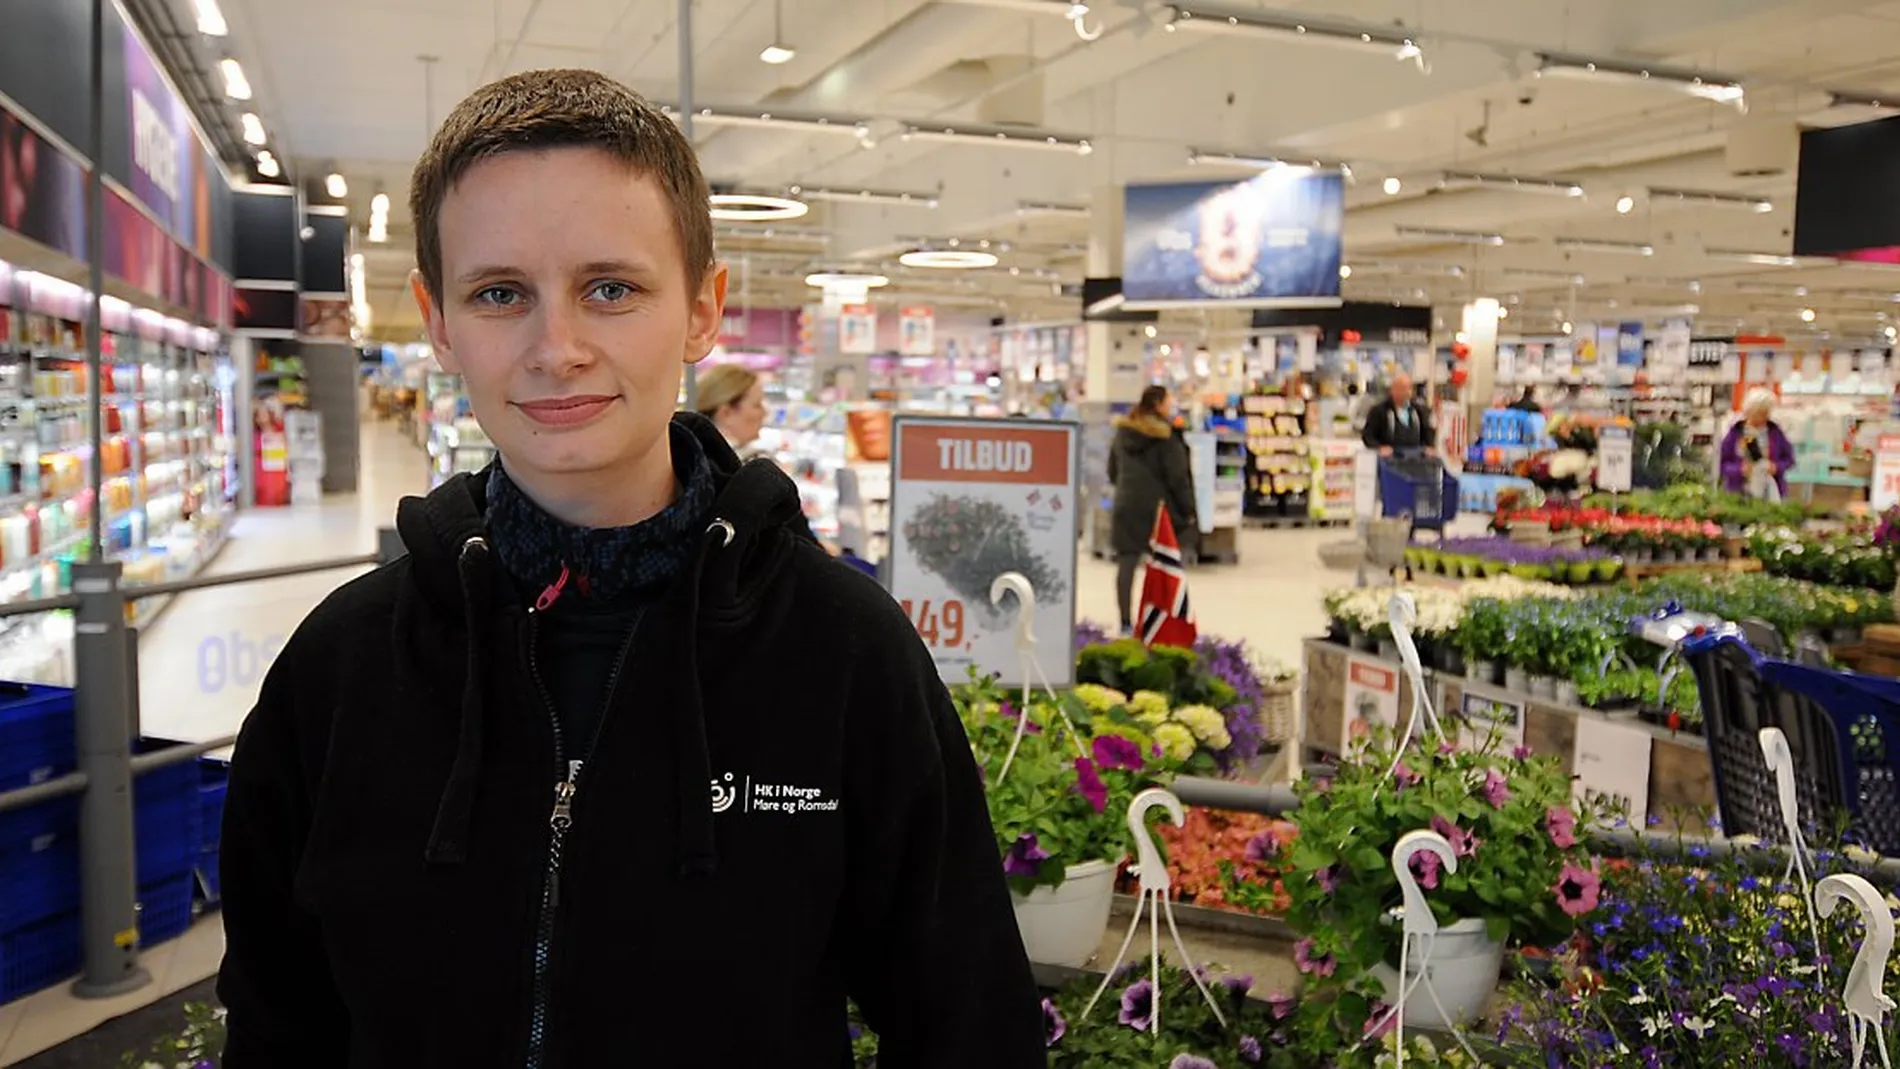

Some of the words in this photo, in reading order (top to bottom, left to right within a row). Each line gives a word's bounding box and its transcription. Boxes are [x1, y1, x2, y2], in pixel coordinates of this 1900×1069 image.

[937, 438, 1032, 473] TILBUD
[755, 784, 774, 797] HK
[775, 785, 780, 797] i
[782, 785, 821, 800] Norge
[782, 802, 796, 814] og
